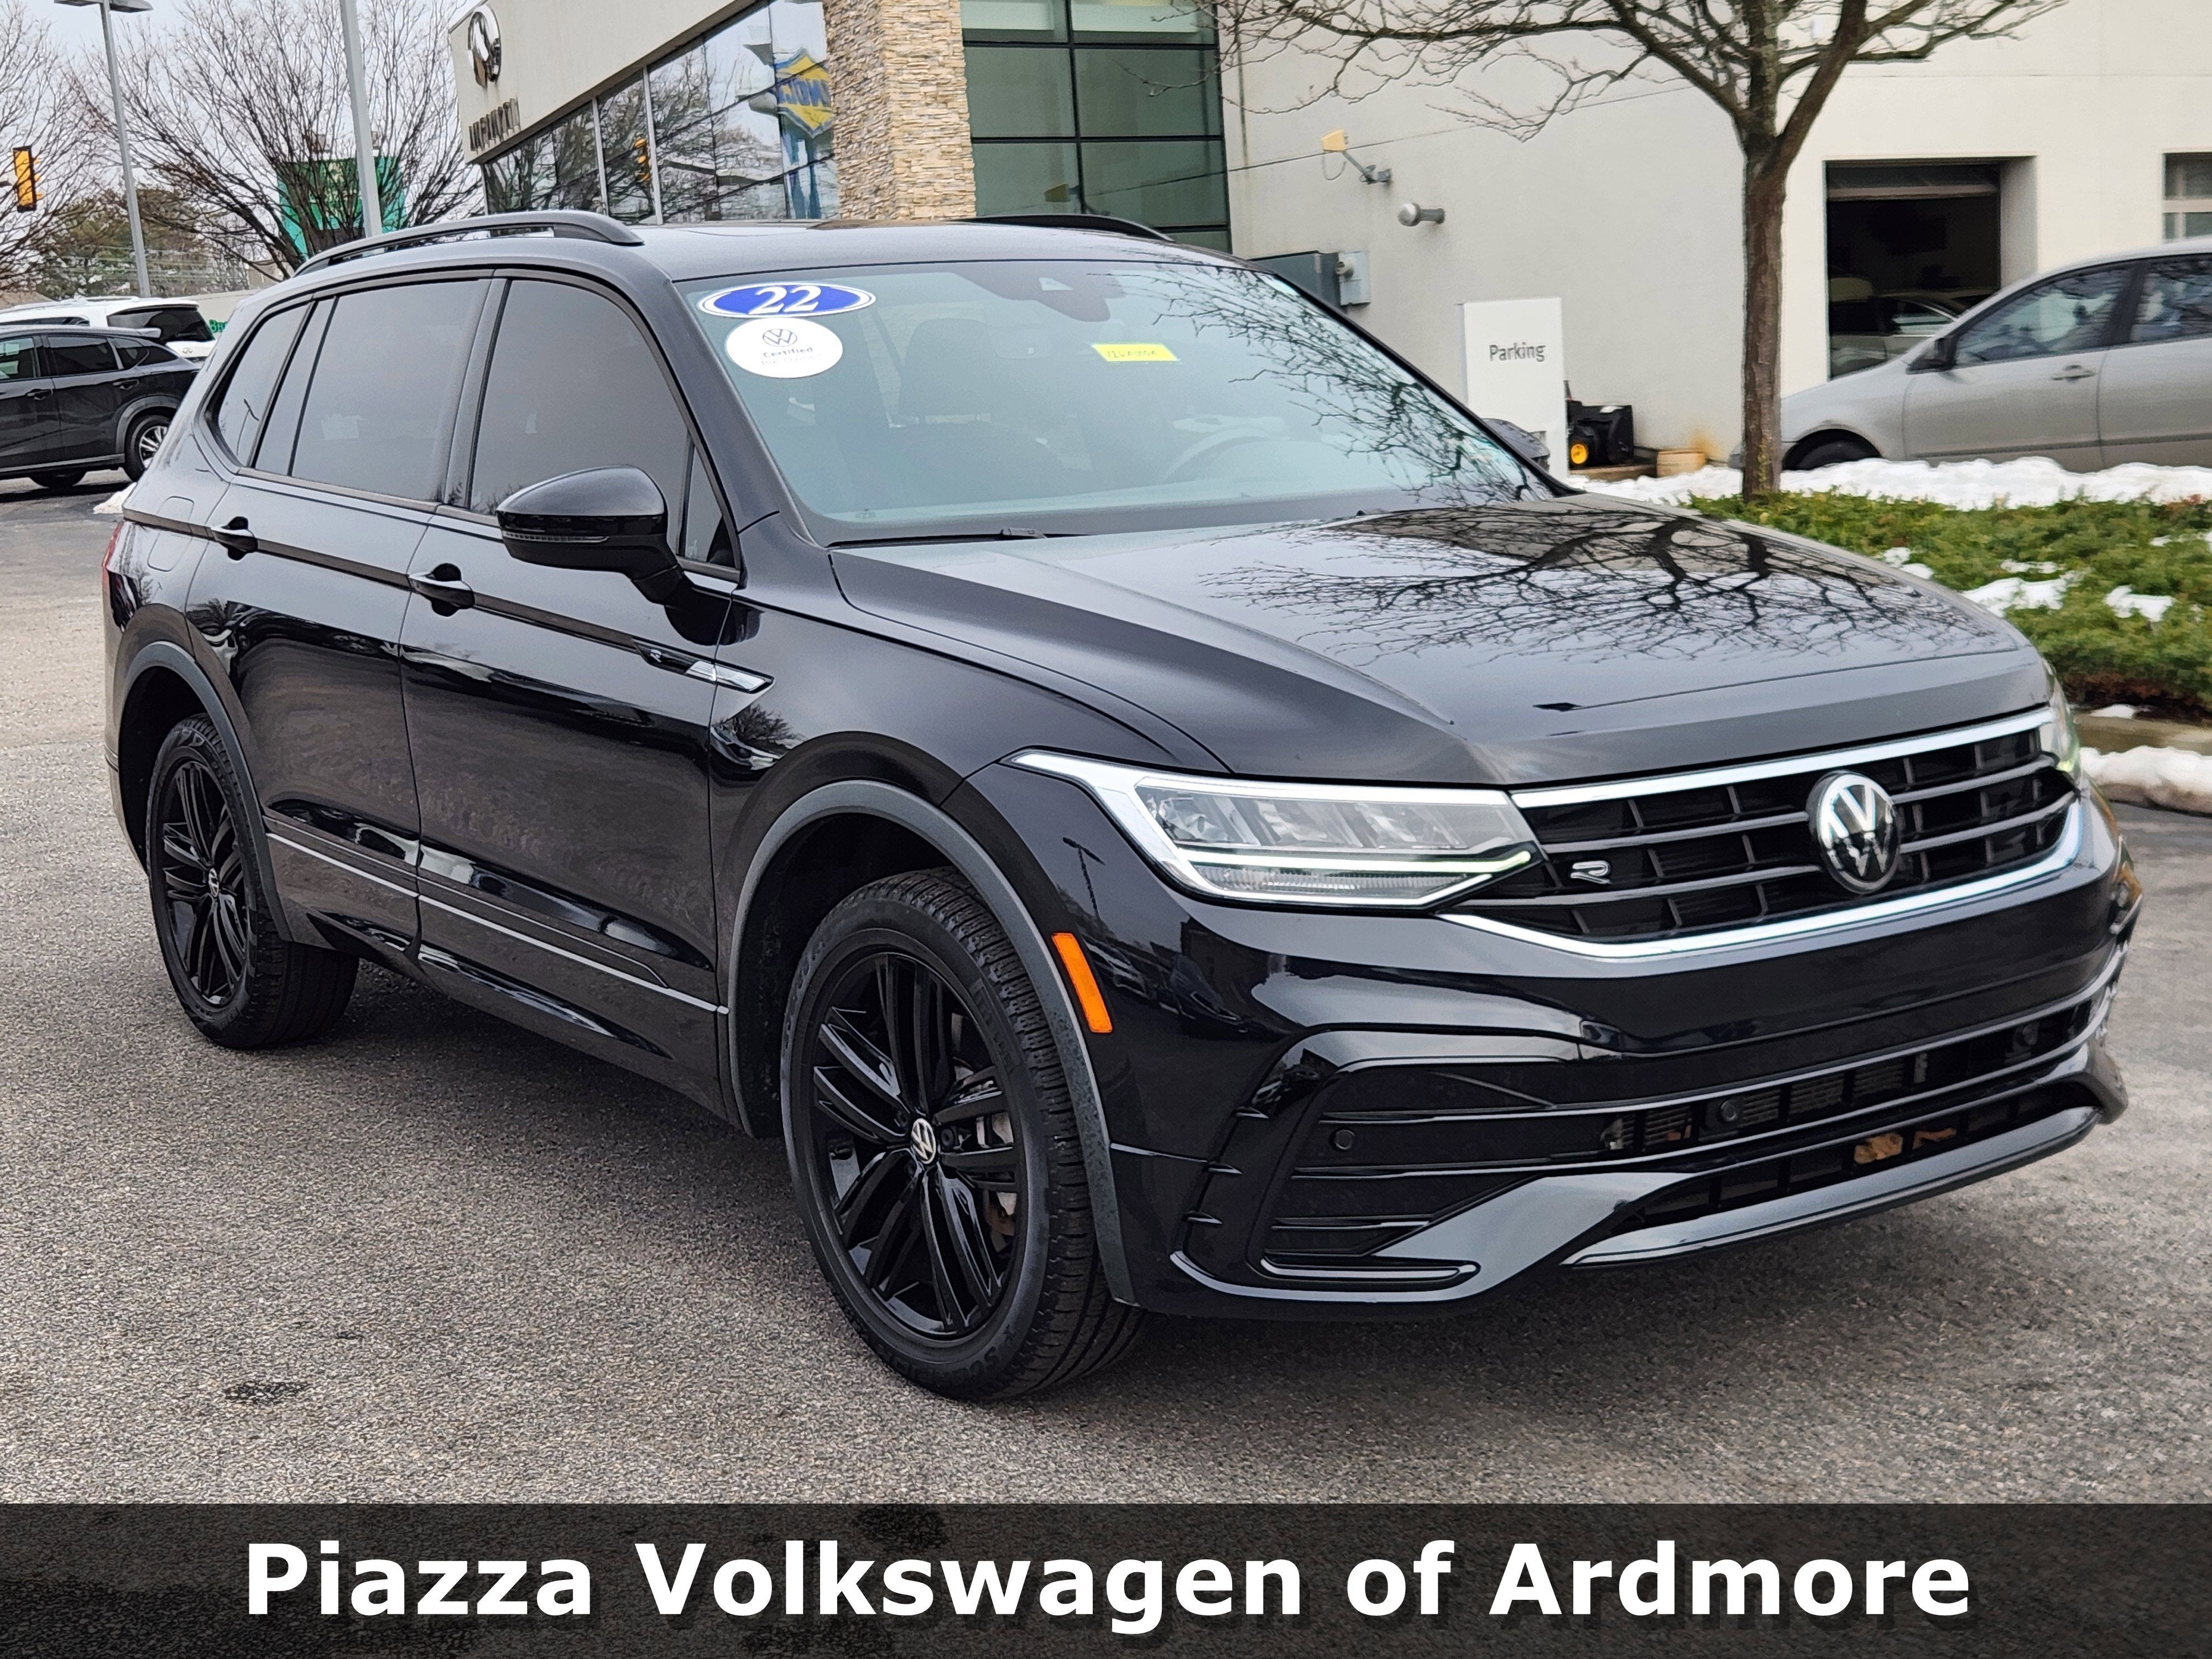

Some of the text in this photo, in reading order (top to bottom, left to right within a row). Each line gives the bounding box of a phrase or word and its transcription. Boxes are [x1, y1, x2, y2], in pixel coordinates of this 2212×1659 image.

[748, 285, 822, 315] 22
[1489, 342, 1546, 362] Parking
[1569, 860, 1611, 884] R
